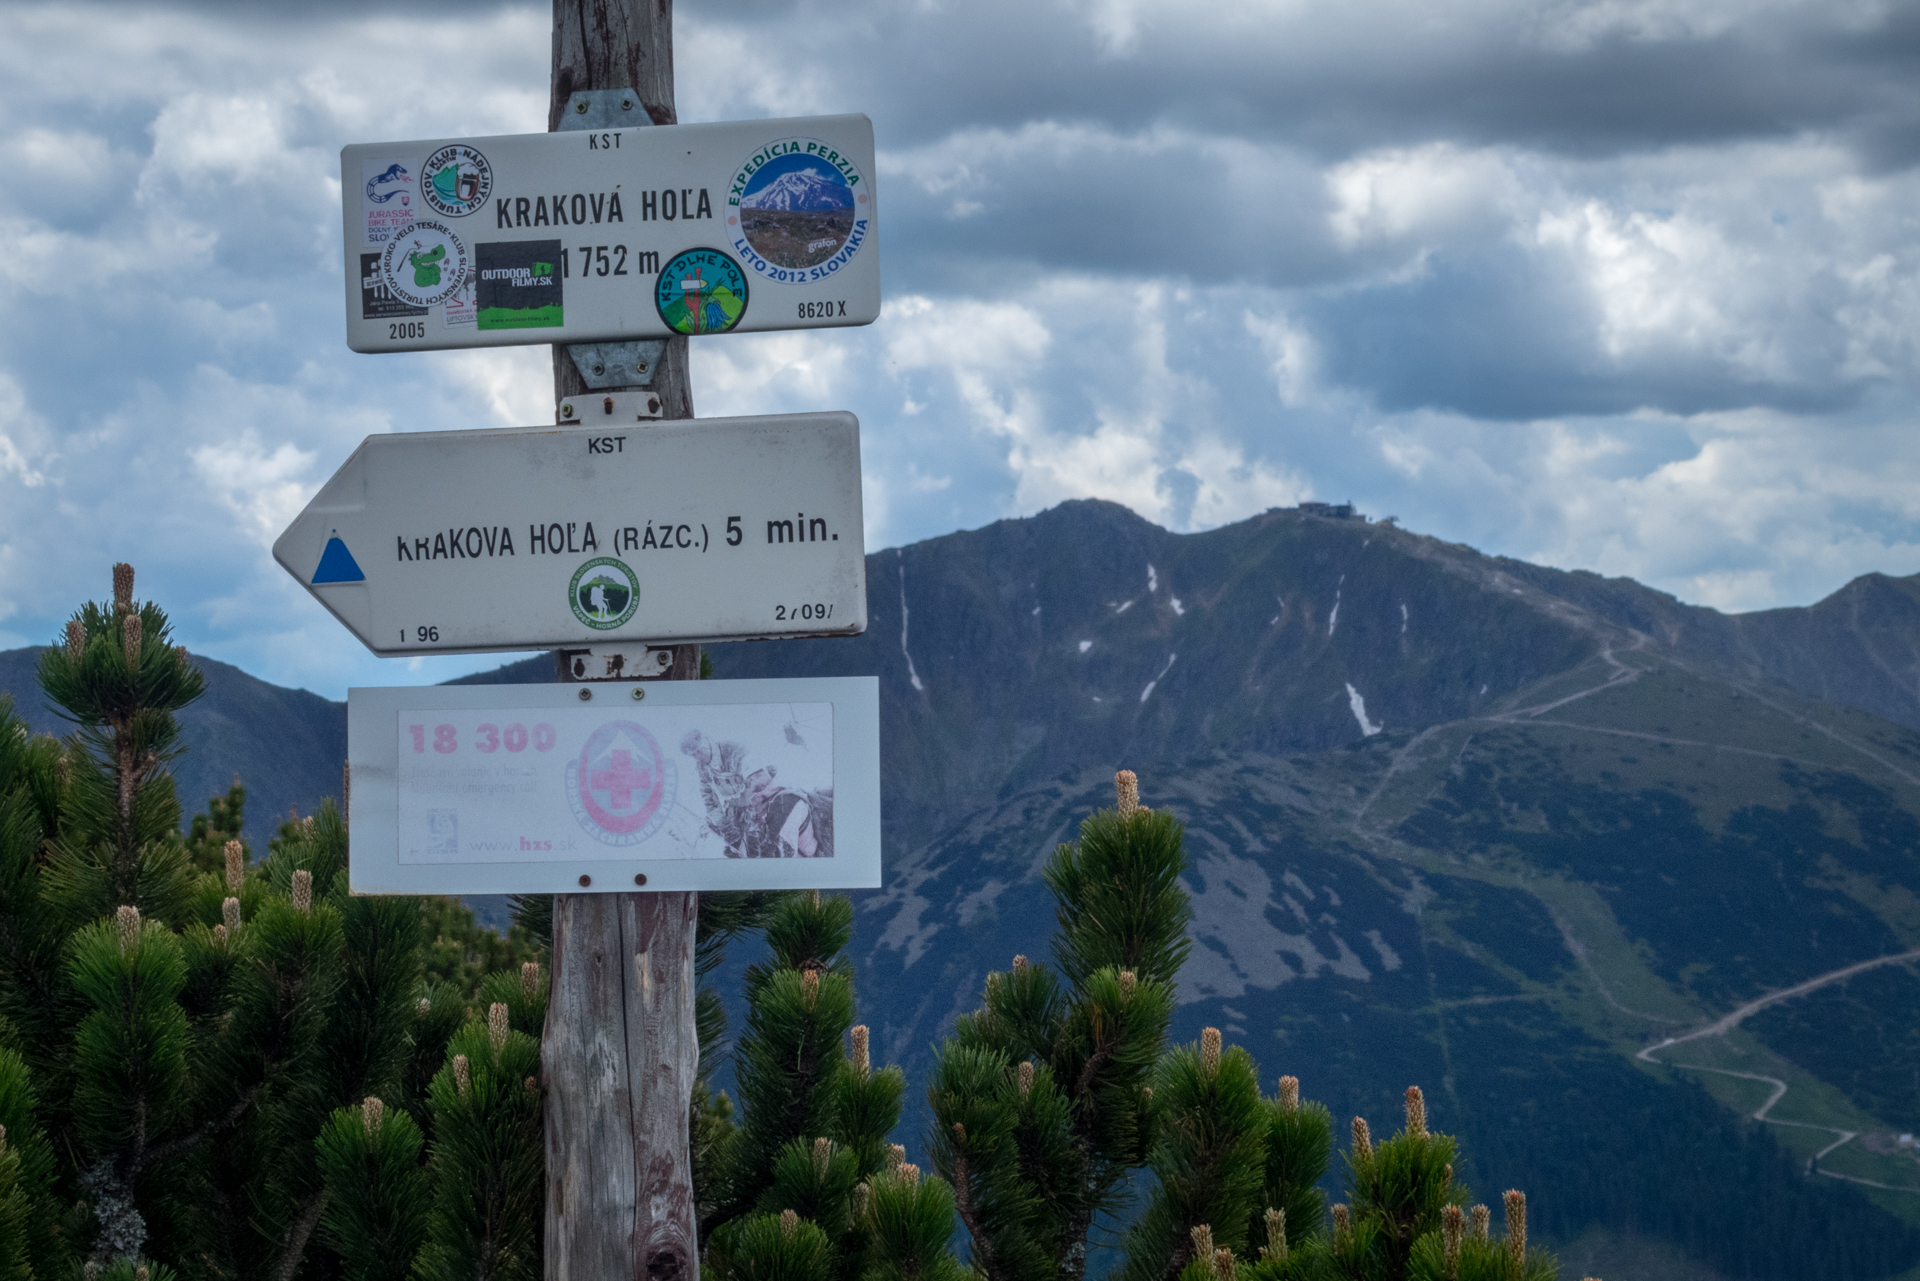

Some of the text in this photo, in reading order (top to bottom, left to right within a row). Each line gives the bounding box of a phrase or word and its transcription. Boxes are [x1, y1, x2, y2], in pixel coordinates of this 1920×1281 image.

[589, 133, 622, 150] KST
[434, 156, 457, 172] MARTIN
[728, 141, 860, 207] EXPEDÍCIA PERZIA
[423, 148, 490, 214] KLUB NÁDEJNÝCH TURISTOV
[368, 208, 414, 219] JURASSIC
[496, 188, 713, 229] KRAKOVÁ HOĽA
[368, 219, 388, 227] BIKE
[415, 220, 449, 236] TESÁRE
[449, 233, 465, 256] KLUB
[734, 219, 868, 283] LETO 2012 SLOVAKIA
[579, 244, 628, 277] 752
[639, 250, 660, 275] m
[481, 268, 531, 281] OUTDOOR
[511, 277, 553, 287] FILMY.SK
[661, 269, 676, 302] KST
[719, 259, 743, 298] POLE
[386, 277, 424, 305] TURISTOV
[798, 300, 846, 318] 8620 X
[389, 322, 425, 339] 2005
[588, 436, 626, 454] KST
[530, 522, 598, 554] HOĽA
[614, 520, 708, 556] (RÁZC.)
[726, 516, 743, 546] 5
[767, 512, 839, 544] min.
[617, 563, 638, 588] TURISTOV
[621, 596, 639, 623] PORUBA
[417, 626, 439, 642] 96
[409, 722, 557, 754] 18 300
[469, 834, 577, 851] www.hzs.sk
